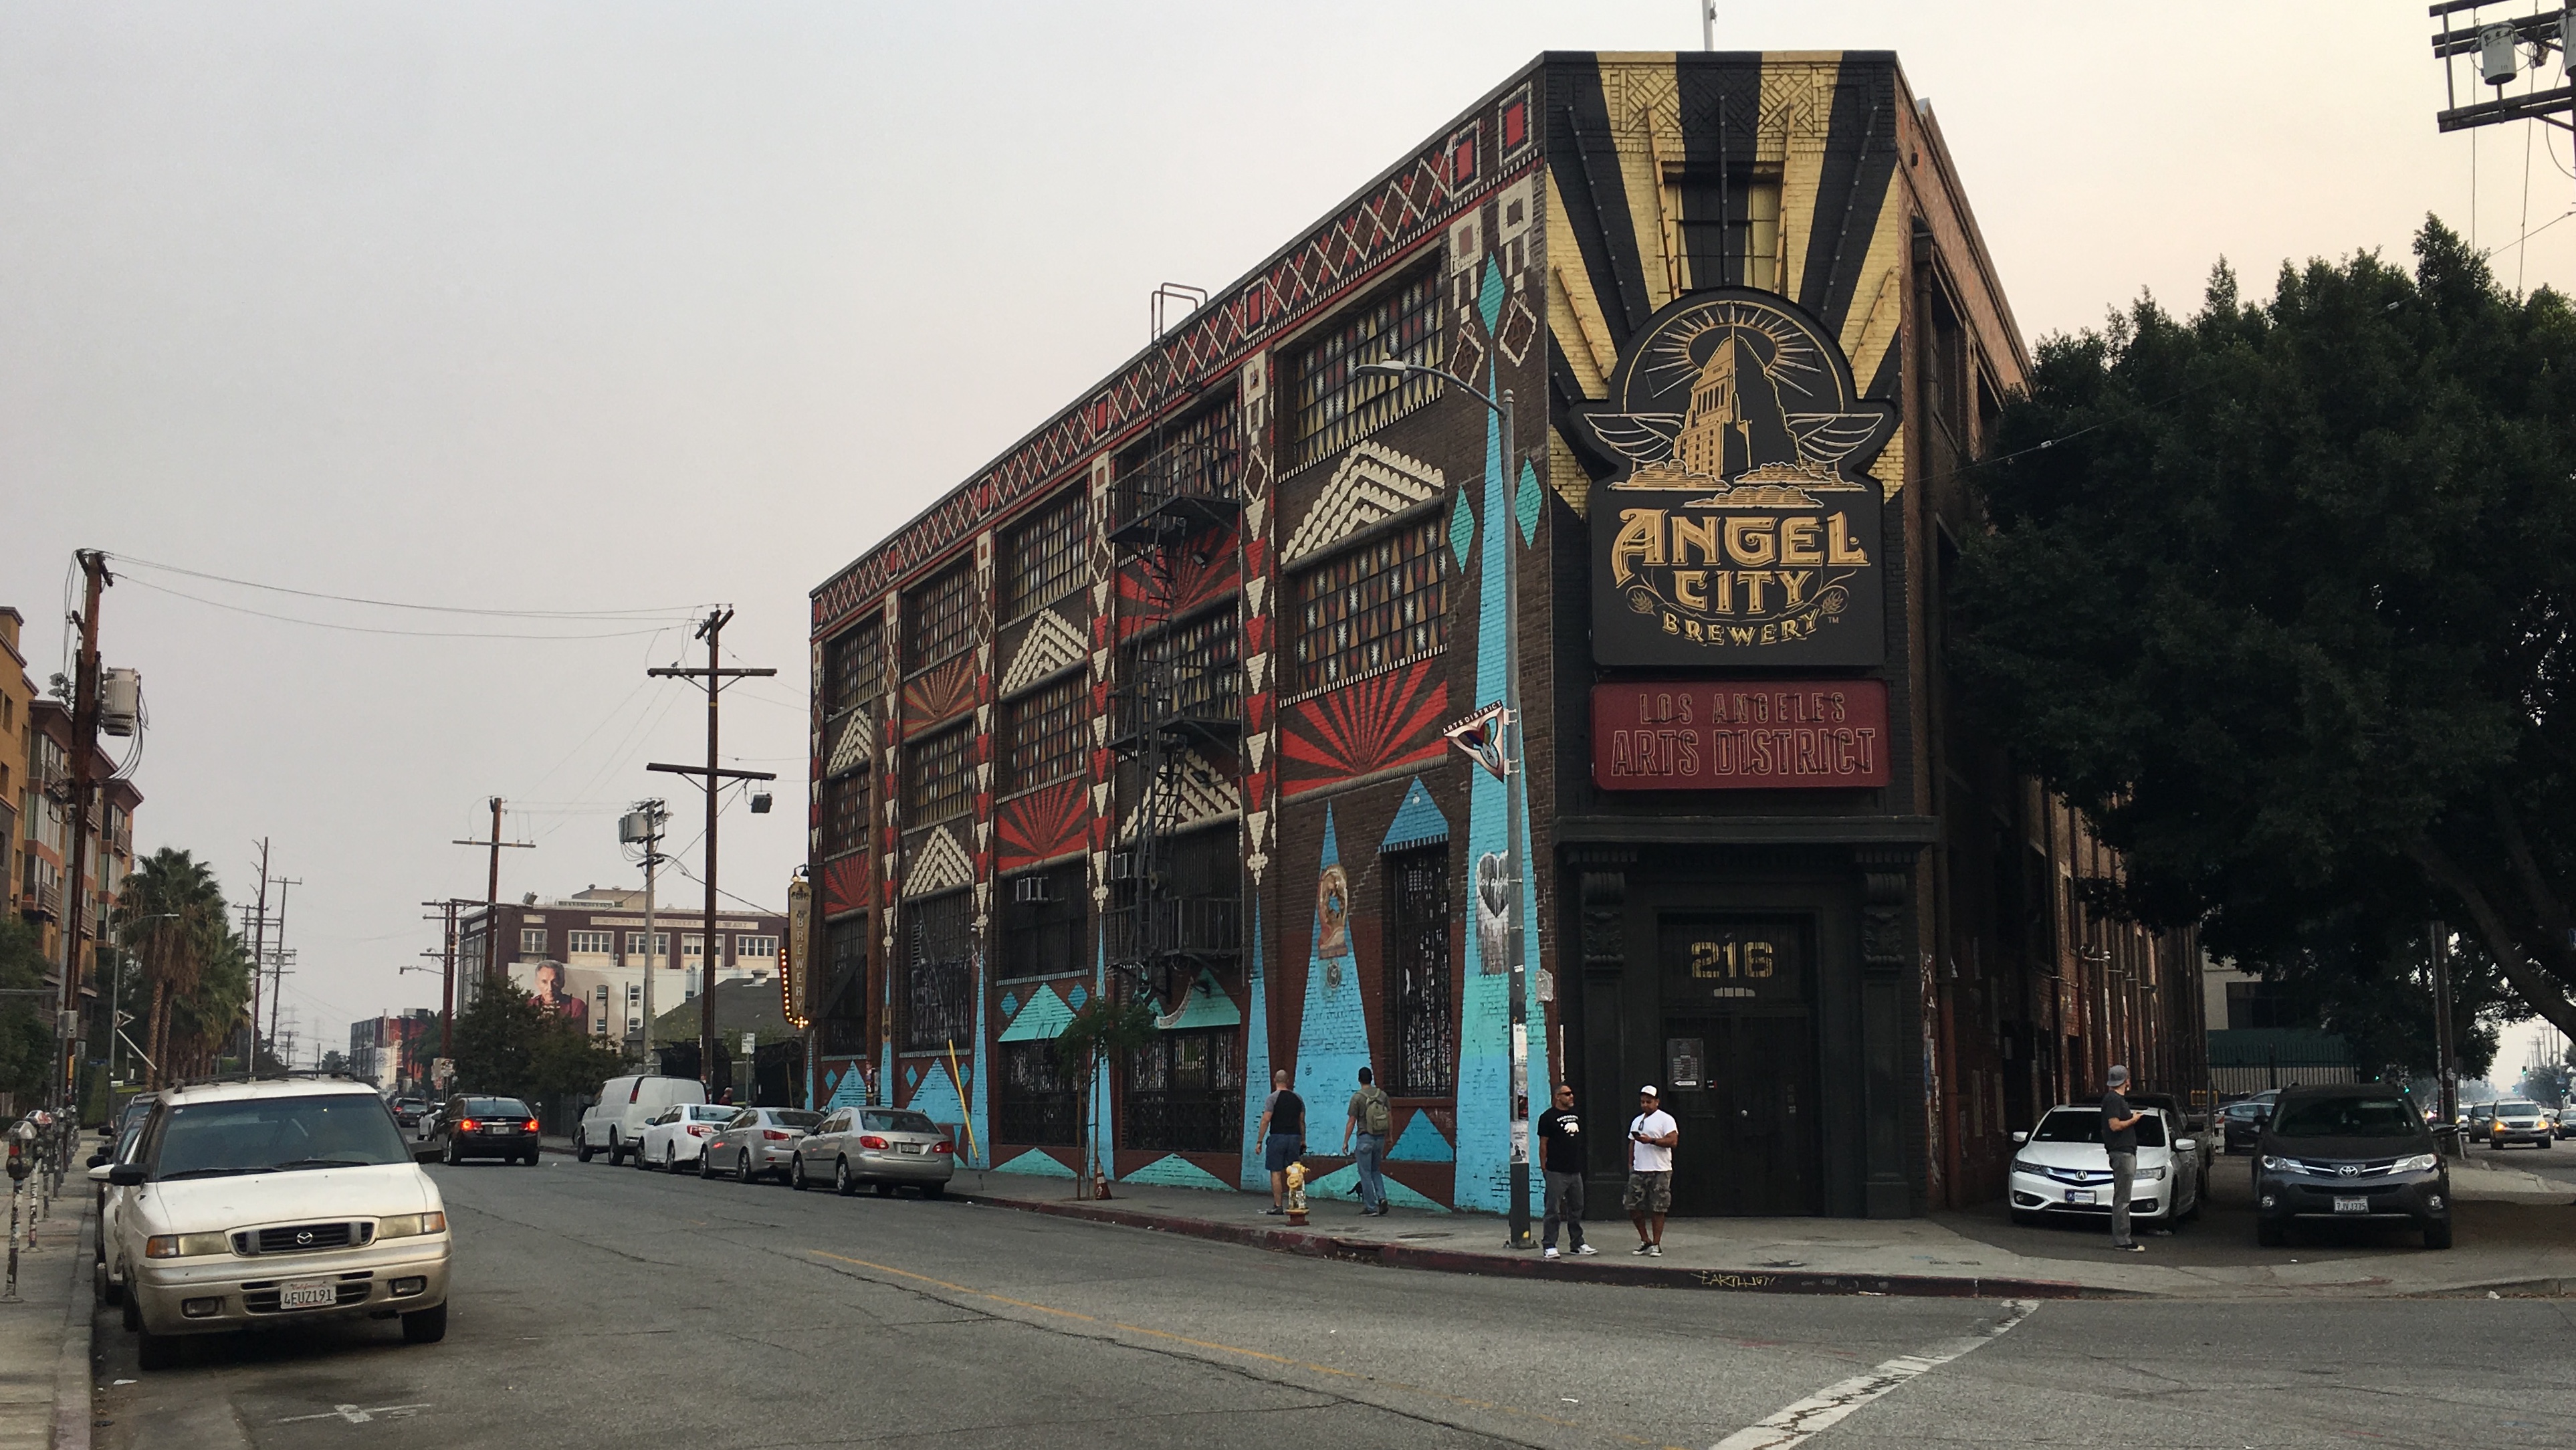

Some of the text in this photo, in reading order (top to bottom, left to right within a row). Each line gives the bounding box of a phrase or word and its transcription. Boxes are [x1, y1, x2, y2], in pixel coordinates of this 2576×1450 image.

[1611, 508, 1870, 587] ANGEL
[1673, 571, 1810, 616] CITY
[1662, 607, 1820, 647] BREWERY
[1443, 701, 1501, 734] ARTS DISTRICT
[1640, 692, 1846, 724] LOS ANGELES
[1611, 728, 1876, 776] ARTS DISTRICT
[795, 918, 804, 1011] BREWERY
[1691, 941, 1774, 978] 216
[284, 1289, 332, 1307] 4EUZ191
